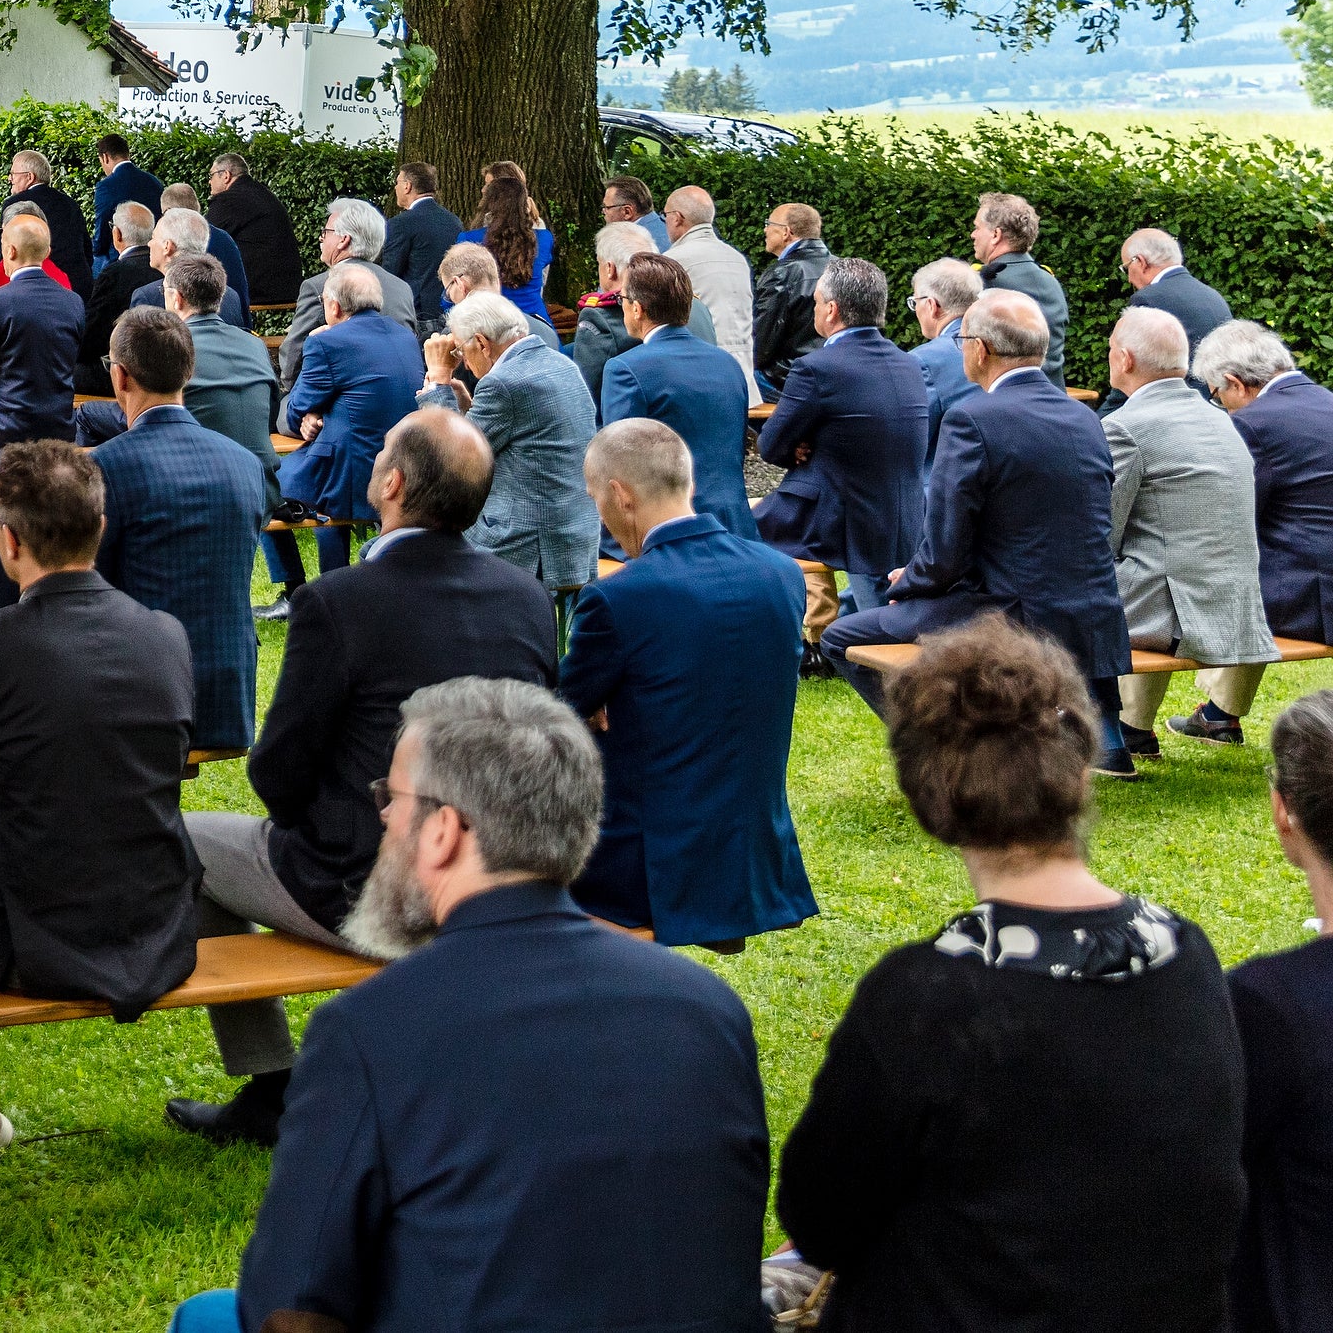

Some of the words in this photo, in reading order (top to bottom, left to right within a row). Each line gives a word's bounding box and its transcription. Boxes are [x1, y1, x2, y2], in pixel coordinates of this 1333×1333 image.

[202, 89, 213, 104] &
[216, 90, 270, 106] Services
[322, 101, 369, 114] Producton
[372, 106, 379, 115] &
